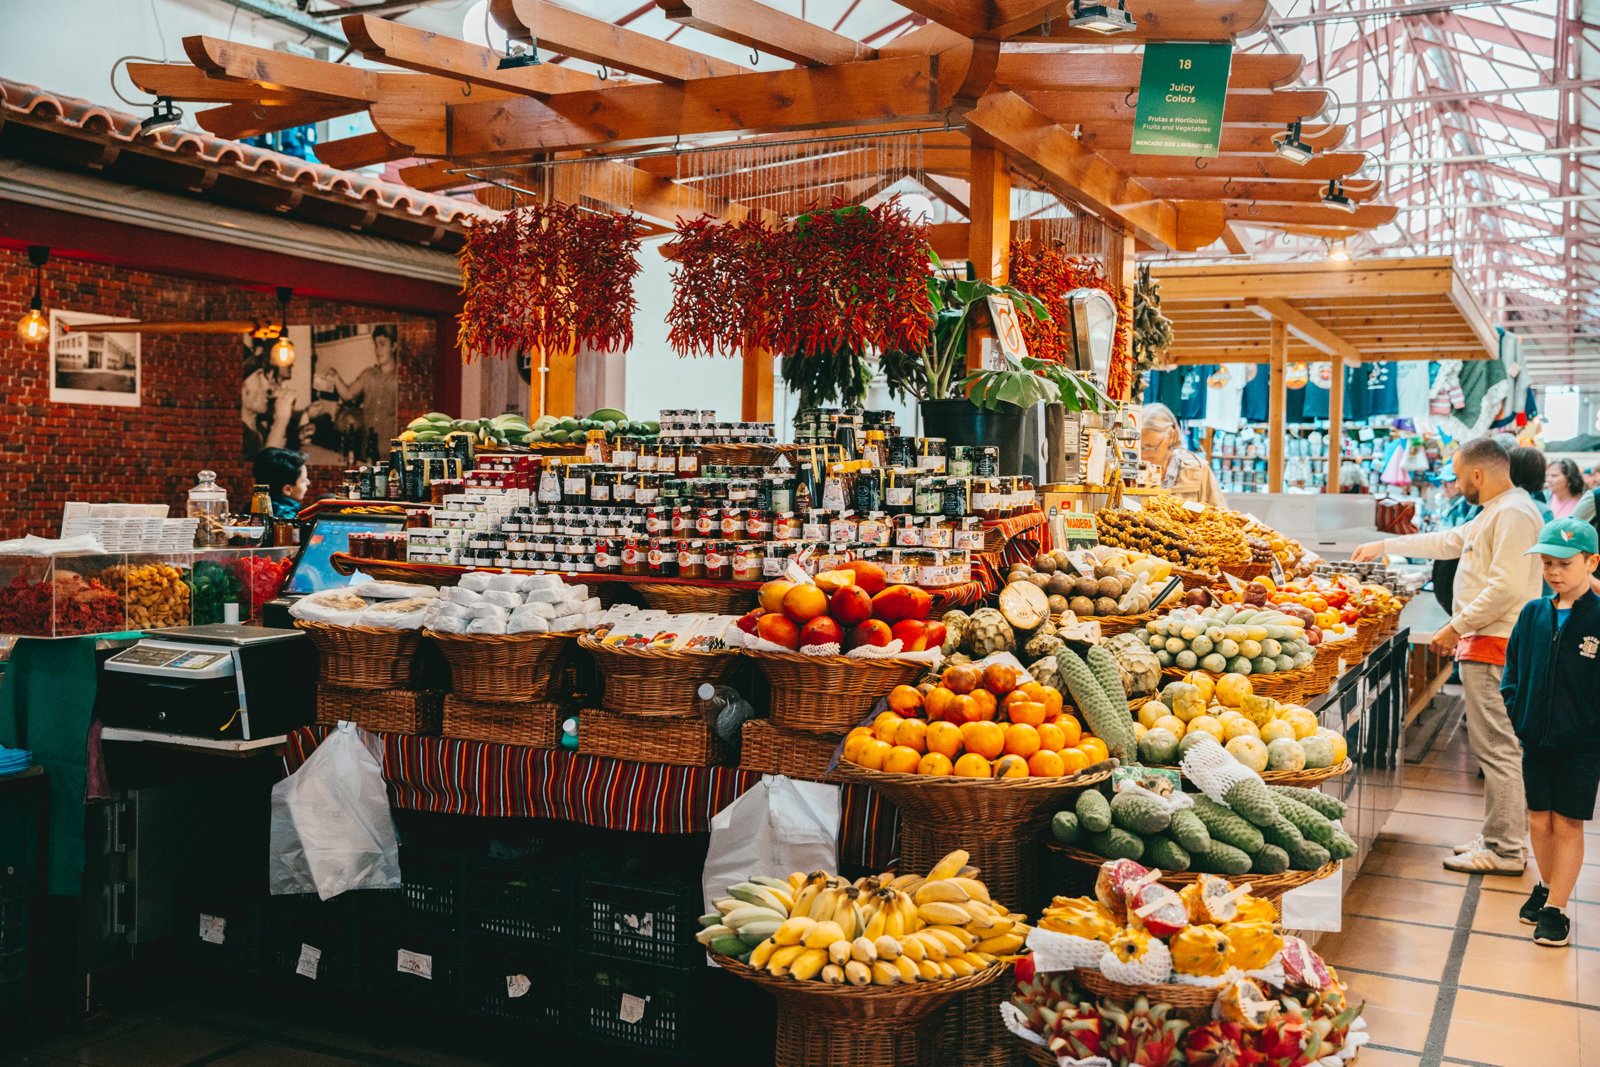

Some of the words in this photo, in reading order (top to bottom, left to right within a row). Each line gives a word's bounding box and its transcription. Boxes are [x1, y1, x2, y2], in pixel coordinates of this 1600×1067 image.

[1179, 59, 1192, 70] 18
[1170, 83, 1195, 94] Juicy
[1165, 94, 1196, 103] Colors
[1175, 125, 1211, 133] Vegetables
[1066, 518, 1093, 529] MADEIRA
